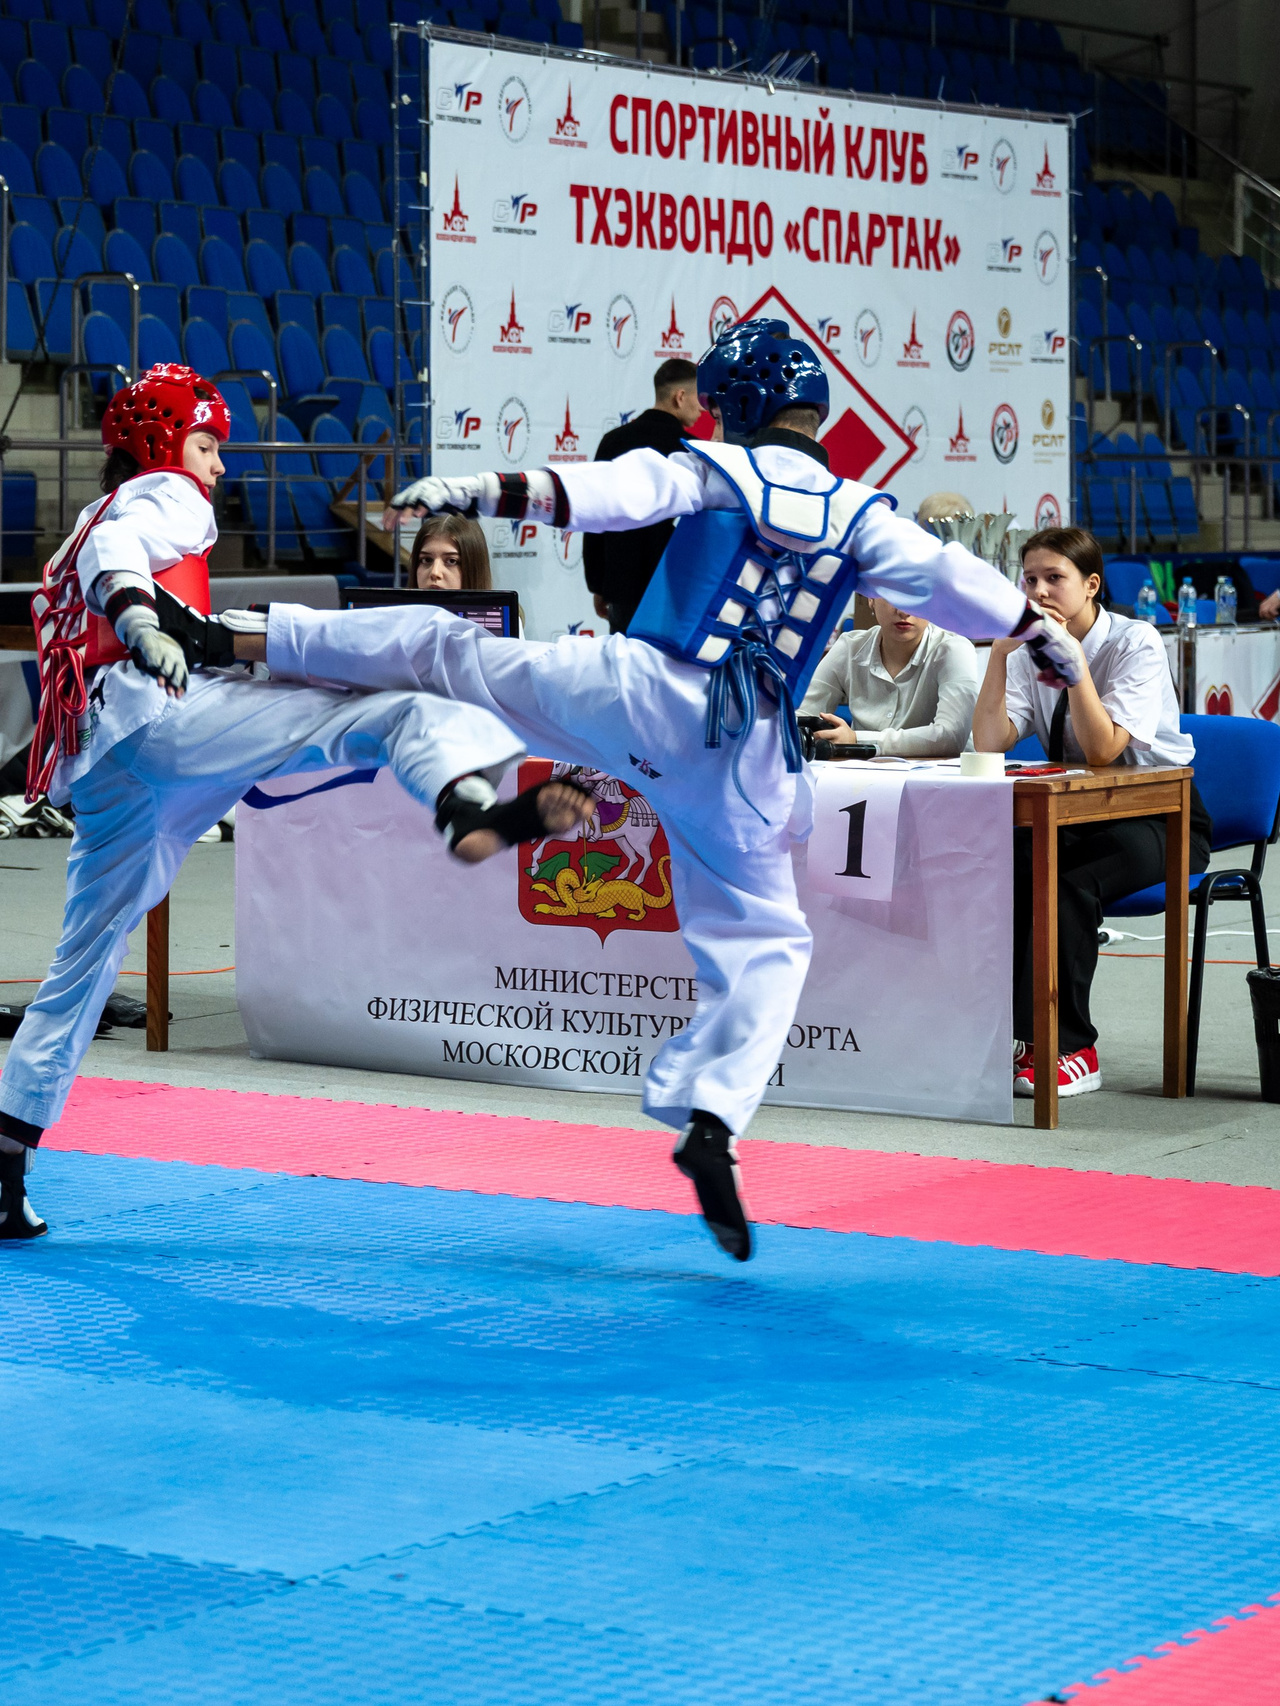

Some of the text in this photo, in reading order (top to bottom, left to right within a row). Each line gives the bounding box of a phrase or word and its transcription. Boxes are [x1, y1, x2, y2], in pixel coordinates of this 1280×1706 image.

[610, 94, 835, 176] СПОРТИВНЫЙ
[845, 125, 928, 185] КЛУБ
[570, 184, 773, 266] ТХЭКВОНДО
[784, 206, 961, 272] «СПАРТАК»
[835, 800, 871, 878] 1
[494, 966, 698, 1002] МИНИСТЕРСТВ
[367, 997, 861, 1052] ФИЗИЧЕСКОЙ КУЛЬТУР ОРТА
[442, 1040, 643, 1077] МОСКОВСКОЙ
